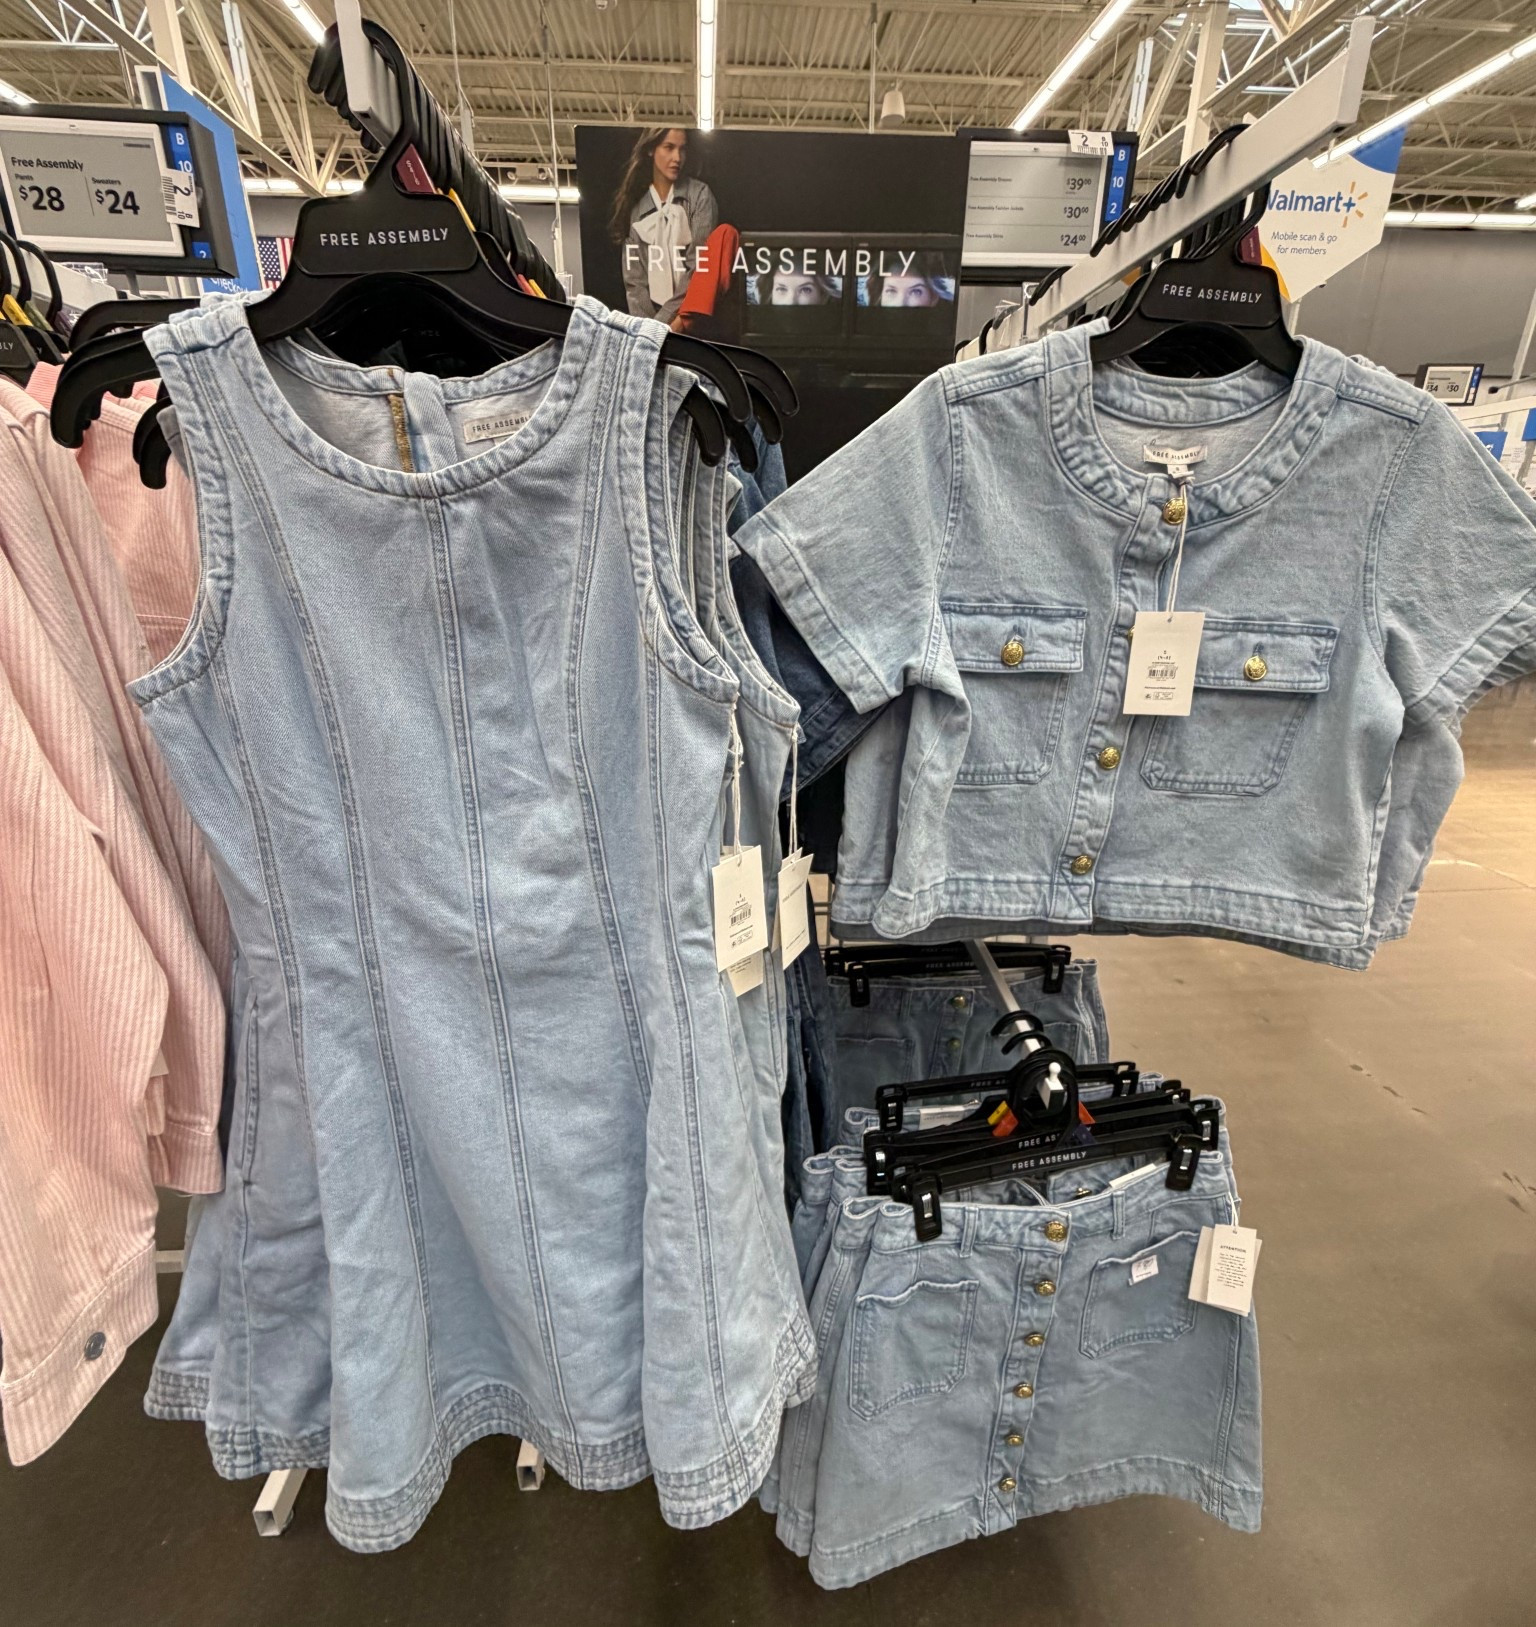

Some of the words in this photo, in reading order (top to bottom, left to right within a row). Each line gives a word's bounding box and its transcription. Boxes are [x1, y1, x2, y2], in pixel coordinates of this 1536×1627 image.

[175, 132, 185, 146] B
[1081, 134, 1089, 147] 2
[1118, 149, 1126, 161] B
[11, 156, 35, 168] Free
[35, 158, 84, 172] Assembly
[178, 160, 193, 173] 10
[15, 173, 34, 181] Pants
[91, 177, 121, 185] Sweaters
[1112, 176, 1124, 188] 10
[18, 184, 65, 212] $28
[95, 188, 141, 215] $24
[1109, 202, 1118, 214] 2
[320, 233, 359, 247] FREE
[367, 227, 449, 245] ASSEMBLY
[1271, 231, 1298, 241] Mobile
[1318, 232, 1325, 241] &
[1326, 235, 1338, 244] go
[1276, 245, 1289, 254] for
[1290, 246, 1327, 255] members
[625, 244, 710, 273] FREE
[731, 246, 916, 277] ASSEMBLY
[1162, 284, 1193, 298] FREE
[1197, 288, 1263, 304] ASSEMBLY
[472, 423, 491, 433] FREE
[494, 415, 531, 429] ASSEMBL
[1018, 1137, 1041, 1149] FREE
[1012, 1161, 1035, 1171] FREE
[1039, 1151, 1087, 1166] ASSEMBLY
